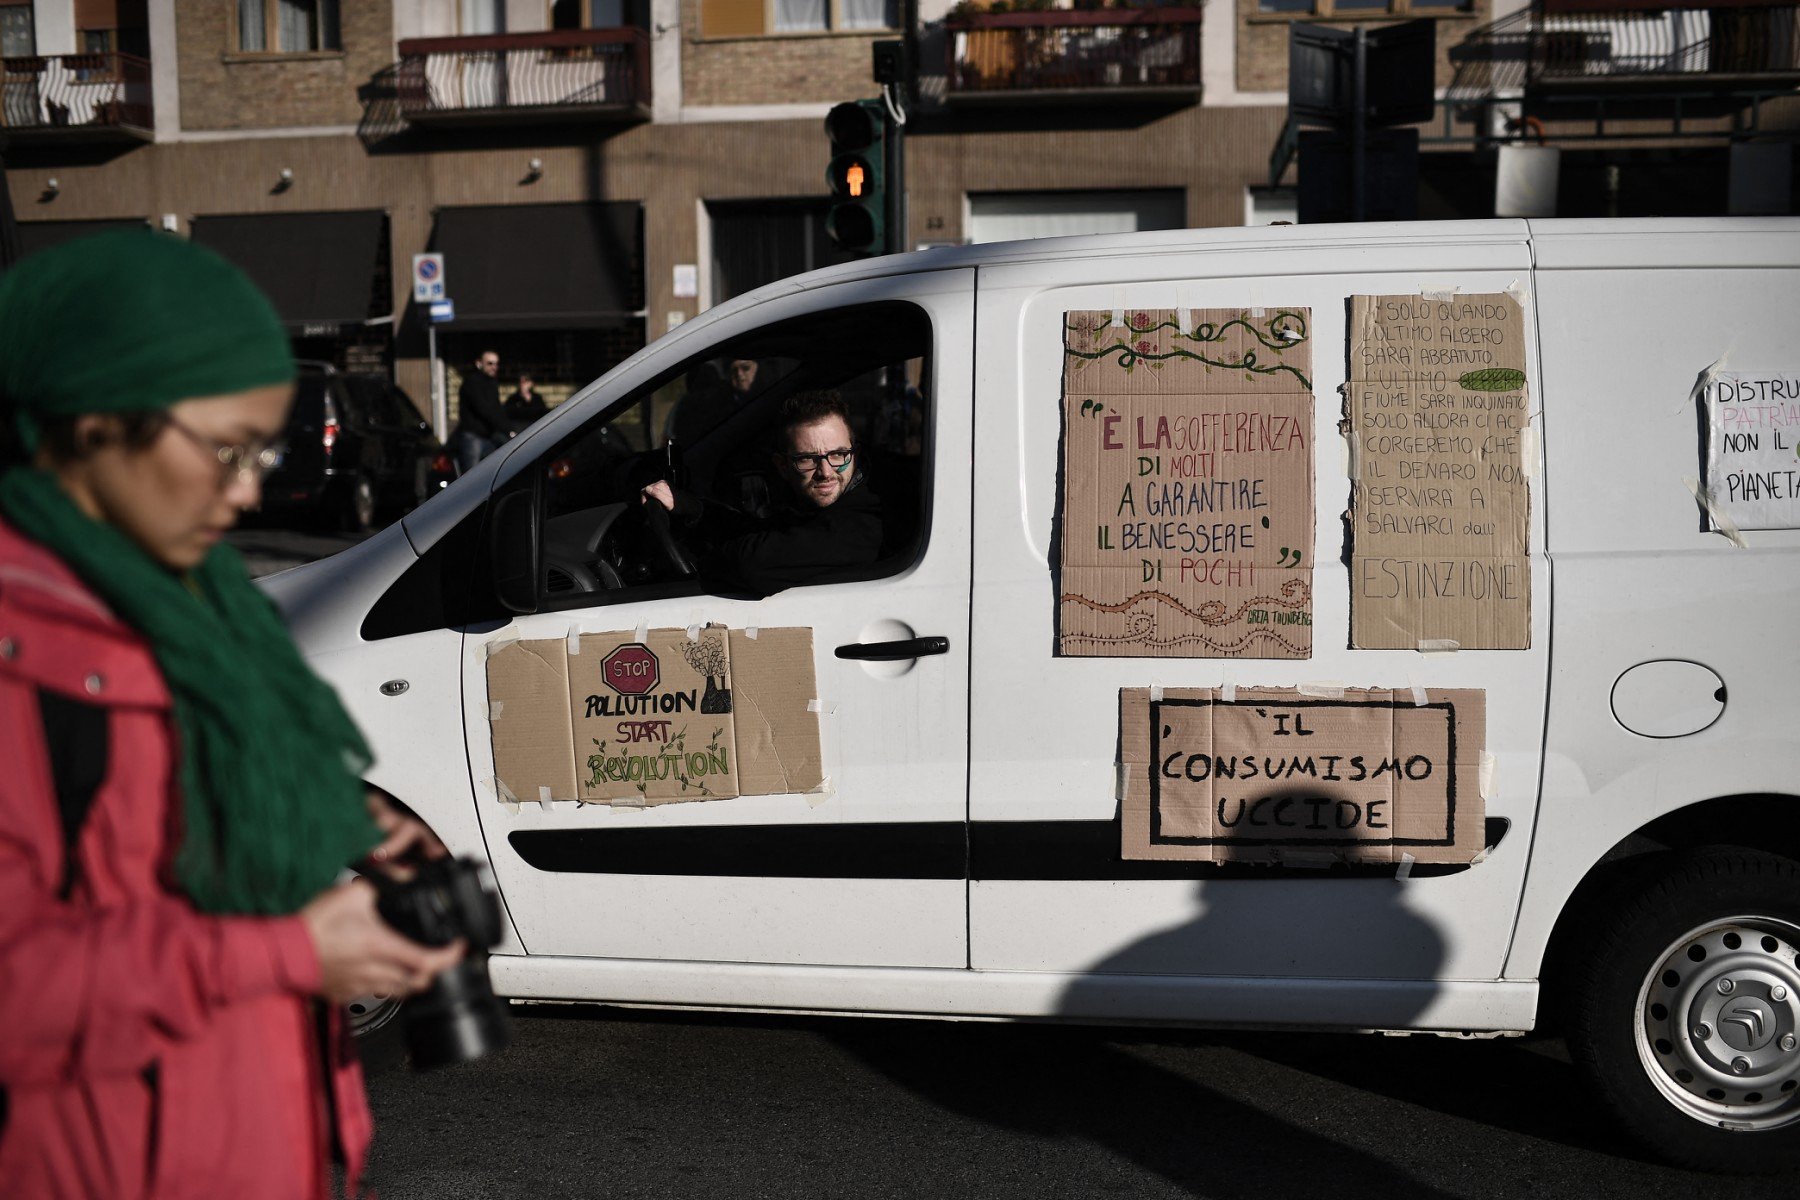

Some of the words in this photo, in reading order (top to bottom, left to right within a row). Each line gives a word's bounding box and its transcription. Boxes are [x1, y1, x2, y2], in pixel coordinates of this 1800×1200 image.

[1386, 302, 1430, 321] SOLO
[1438, 304, 1507, 321] QUANDO
[1362, 325, 1432, 342] L'ULTIMO
[1440, 327, 1503, 345] ALBERO
[1365, 369, 1446, 392] L'ULTIMO
[1718, 379, 1800, 402] DISTRU
[1364, 392, 1408, 408] FIUME
[1364, 413, 1407, 429] SOLO
[1414, 412, 1468, 429] ALLORA
[1475, 415, 1489, 428] CI
[1722, 402, 1800, 430] PATRIA
[1136, 416, 1172, 449] LA
[1174, 412, 1305, 453] SOFFERENZA
[1723, 433, 1758, 454] NON
[1366, 435, 1473, 454] CORGEREMO
[1483, 435, 1517, 455] CHE
[1138, 456, 1160, 476] DI
[1171, 452, 1214, 478] MOLTI
[1369, 461, 1386, 478] IL
[1399, 461, 1476, 480] DENARO
[1488, 463, 1524, 486] NON
[1118, 483, 1135, 516] A
[1147, 479, 1267, 516] GARANTIRE
[1470, 488, 1485, 509] A
[1366, 512, 1453, 535] SALVARCI
[1098, 525, 1114, 549] IL
[1122, 523, 1254, 553] BENESSERE
[1141, 559, 1162, 583] DI
[1363, 559, 1519, 600] ESTINZIONE
[613, 660, 651, 678] STOP
[584, 689, 697, 718] POLLUTION
[615, 720, 672, 743] START
[1272, 713, 1314, 736] IL
[1162, 751, 1433, 782] CONSUMISMO
[1217, 797, 1388, 830] UCCIDE
